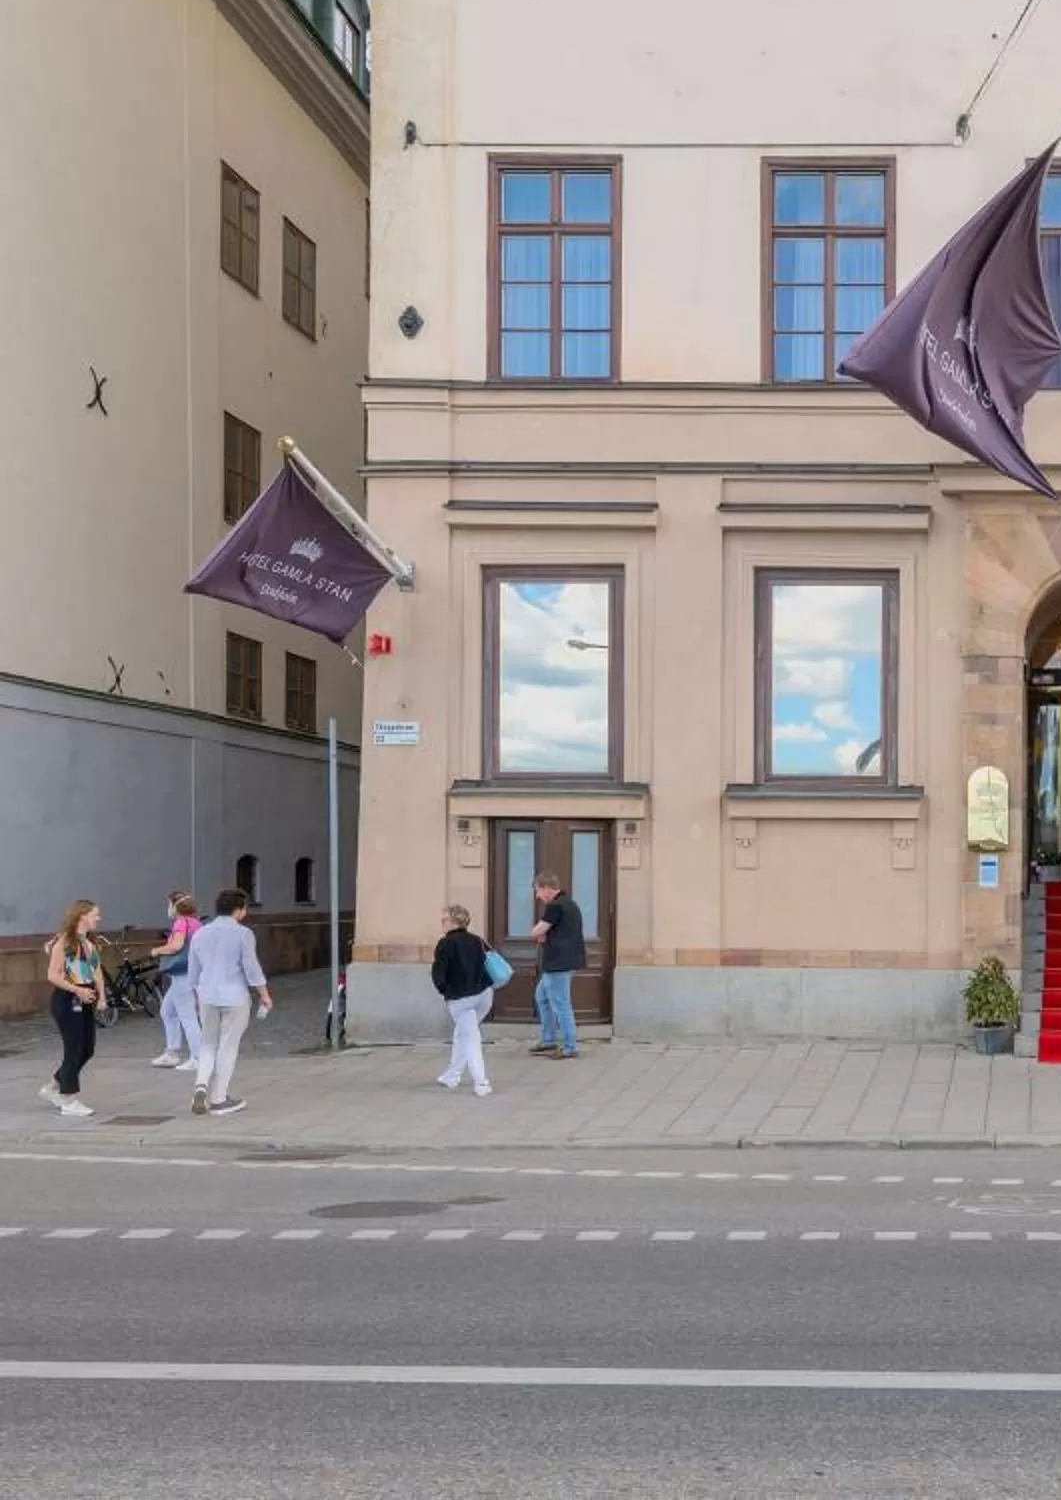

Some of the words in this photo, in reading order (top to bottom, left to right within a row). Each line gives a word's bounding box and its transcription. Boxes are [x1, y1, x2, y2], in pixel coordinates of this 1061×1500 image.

[239, 550, 271, 571] HOTEL
[271, 560, 314, 586] GAMLA
[314, 576, 354, 604] STAN
